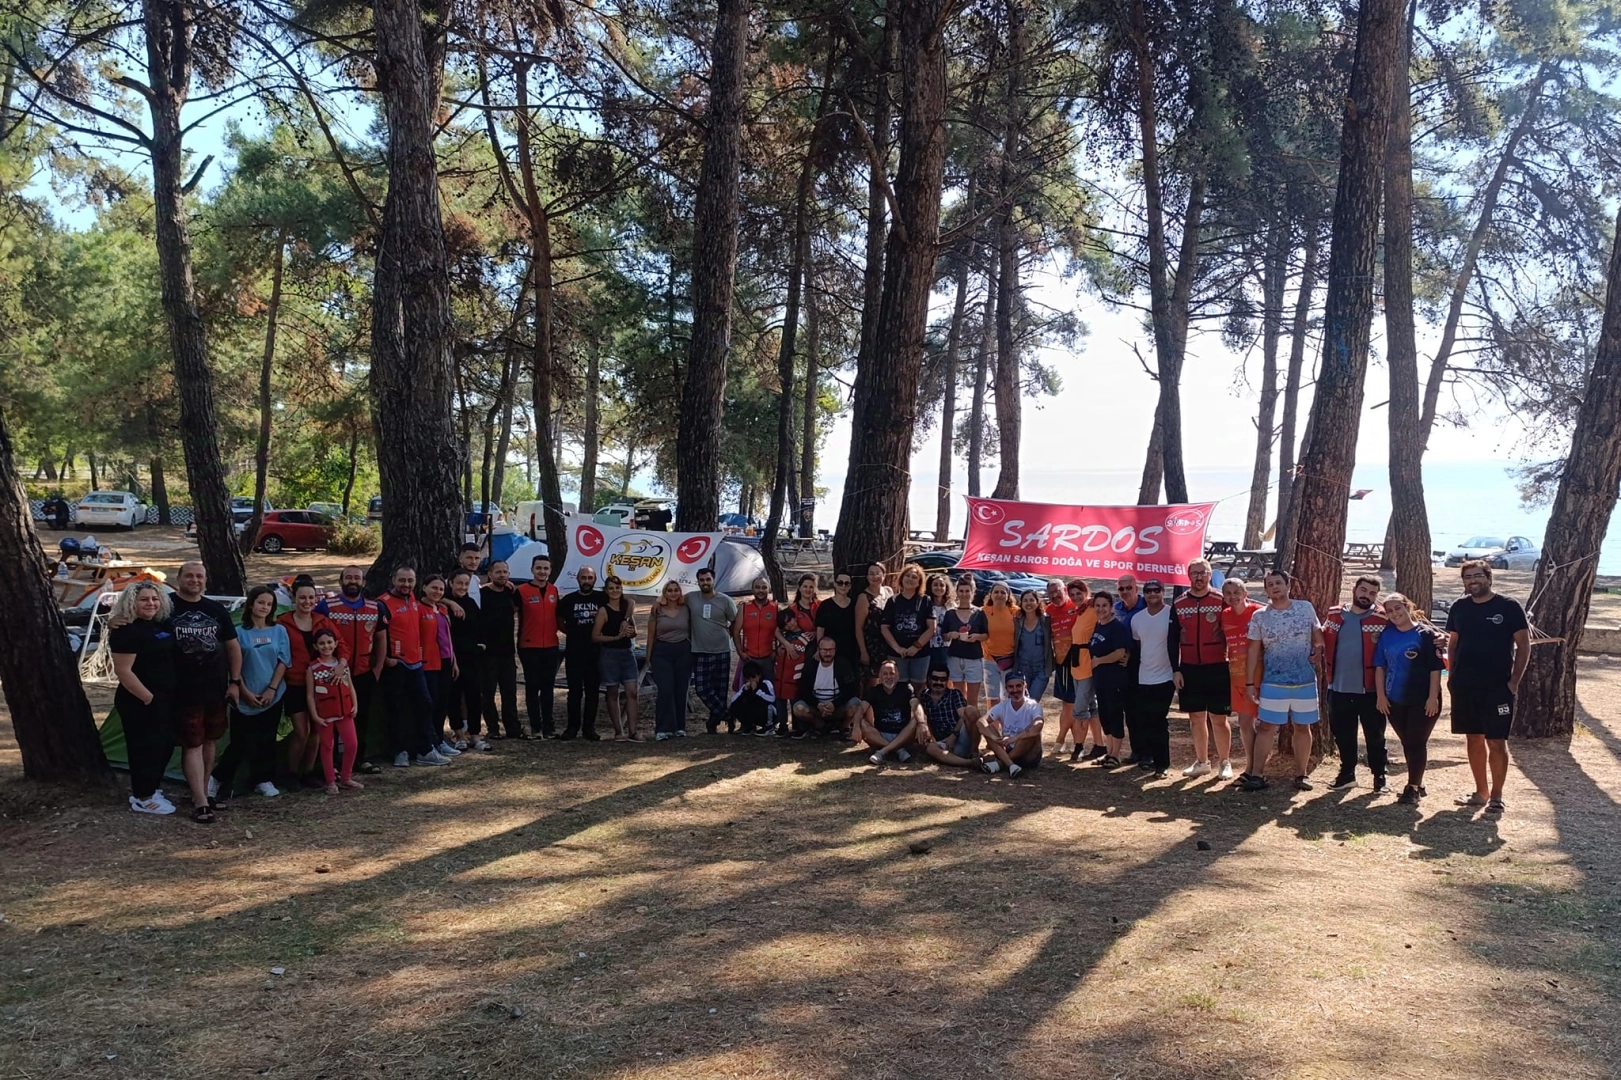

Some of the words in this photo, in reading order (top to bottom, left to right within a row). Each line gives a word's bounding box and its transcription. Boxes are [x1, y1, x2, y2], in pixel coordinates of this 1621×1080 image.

[1000, 520, 1164, 555] SARDOS
[610, 554, 664, 568] KEŞAN
[976, 553, 1011, 564] KEŞAN
[1013, 555, 1049, 565] SAROS
[1052, 556, 1083, 568] DOĞA
[1086, 559, 1101, 568] VE
[1103, 560, 1134, 571] SPOR
[1137, 562, 1187, 576] DERNEĞİ
[574, 602, 599, 611] BKLYN
[175, 626, 217, 640] CHOPPERS
